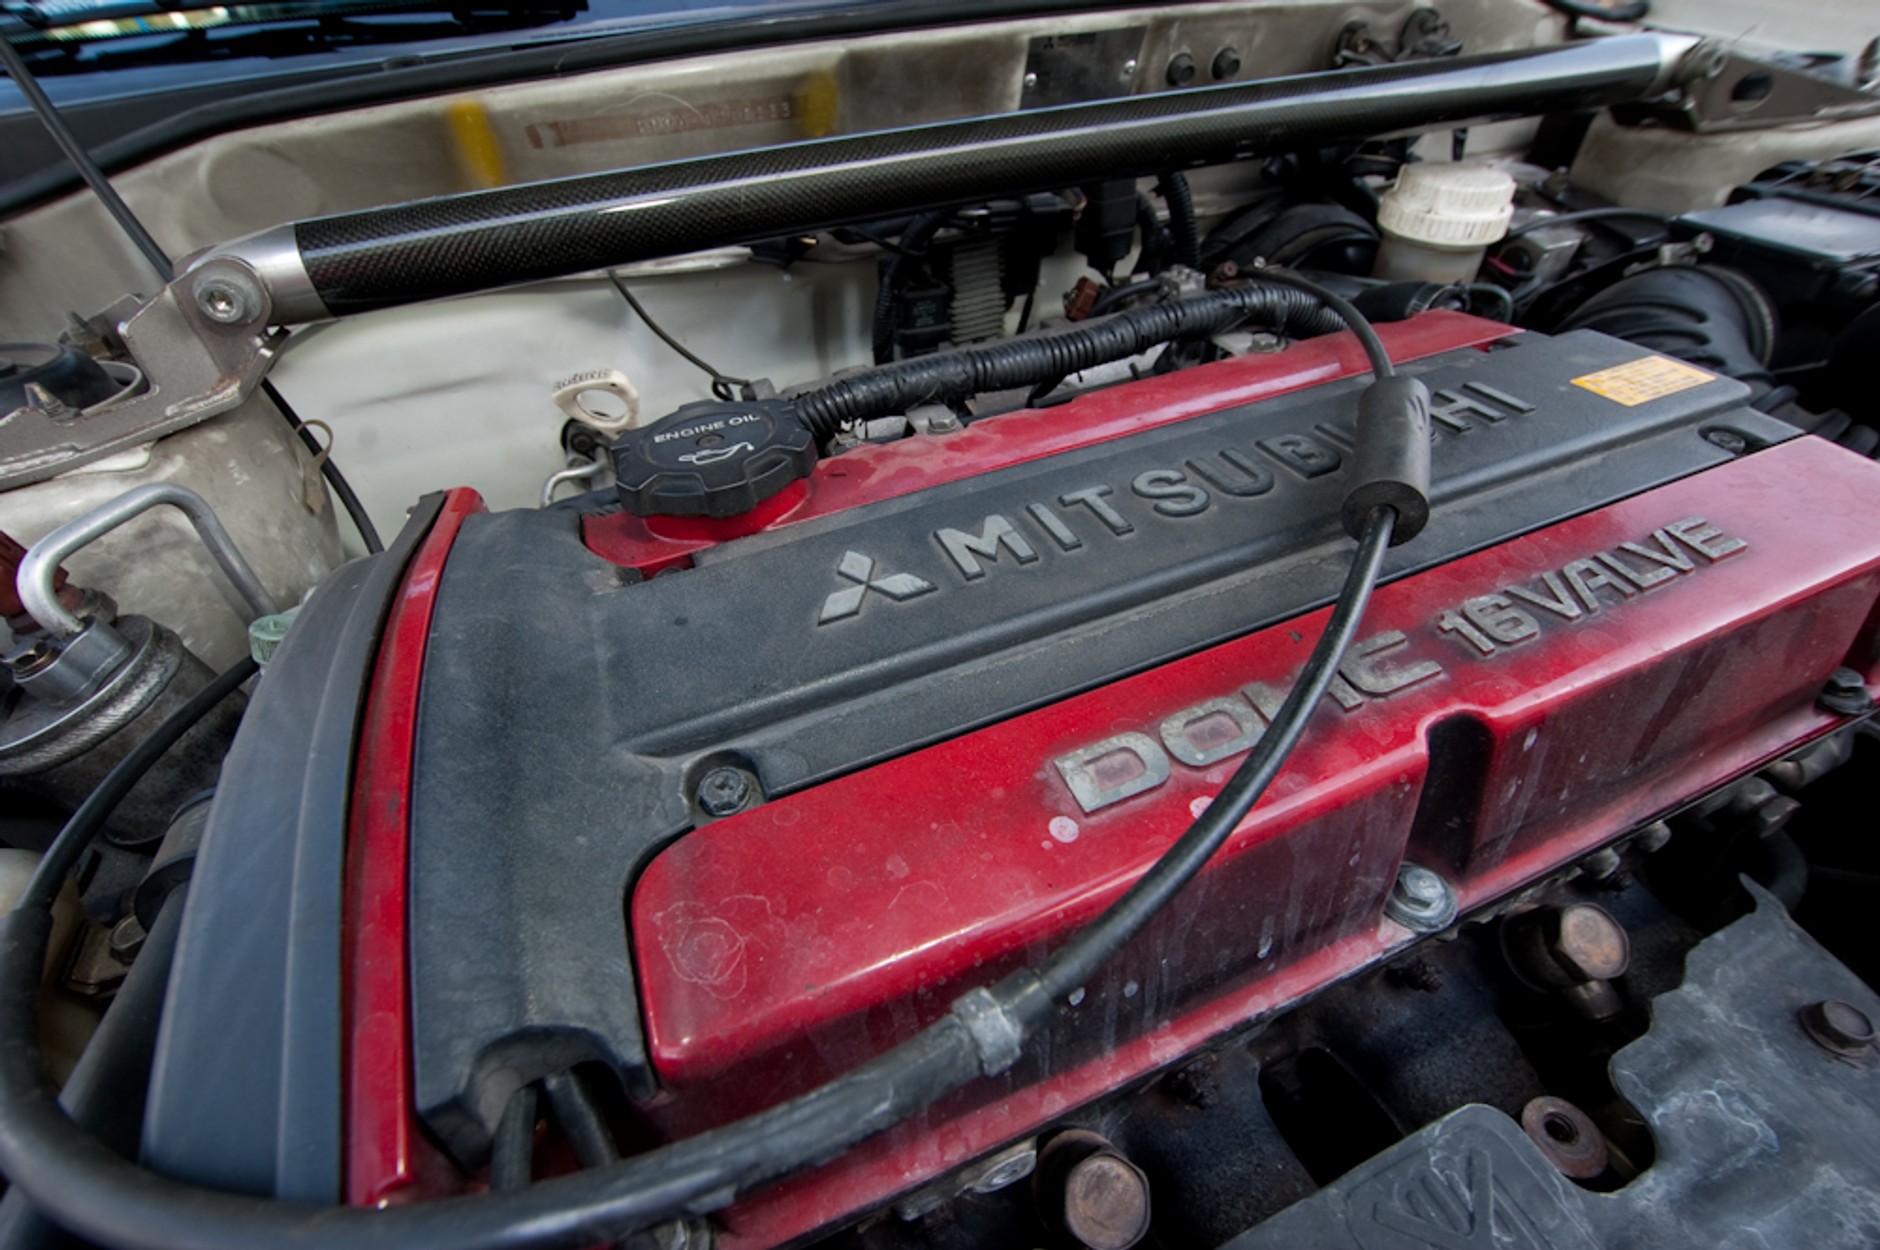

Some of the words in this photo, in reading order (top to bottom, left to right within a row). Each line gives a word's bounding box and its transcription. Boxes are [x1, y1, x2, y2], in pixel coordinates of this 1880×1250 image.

[654, 421, 725, 443] ENGINE
[729, 414, 760, 426] OIL
[933, 382, 1536, 580] MITSUBIHI
